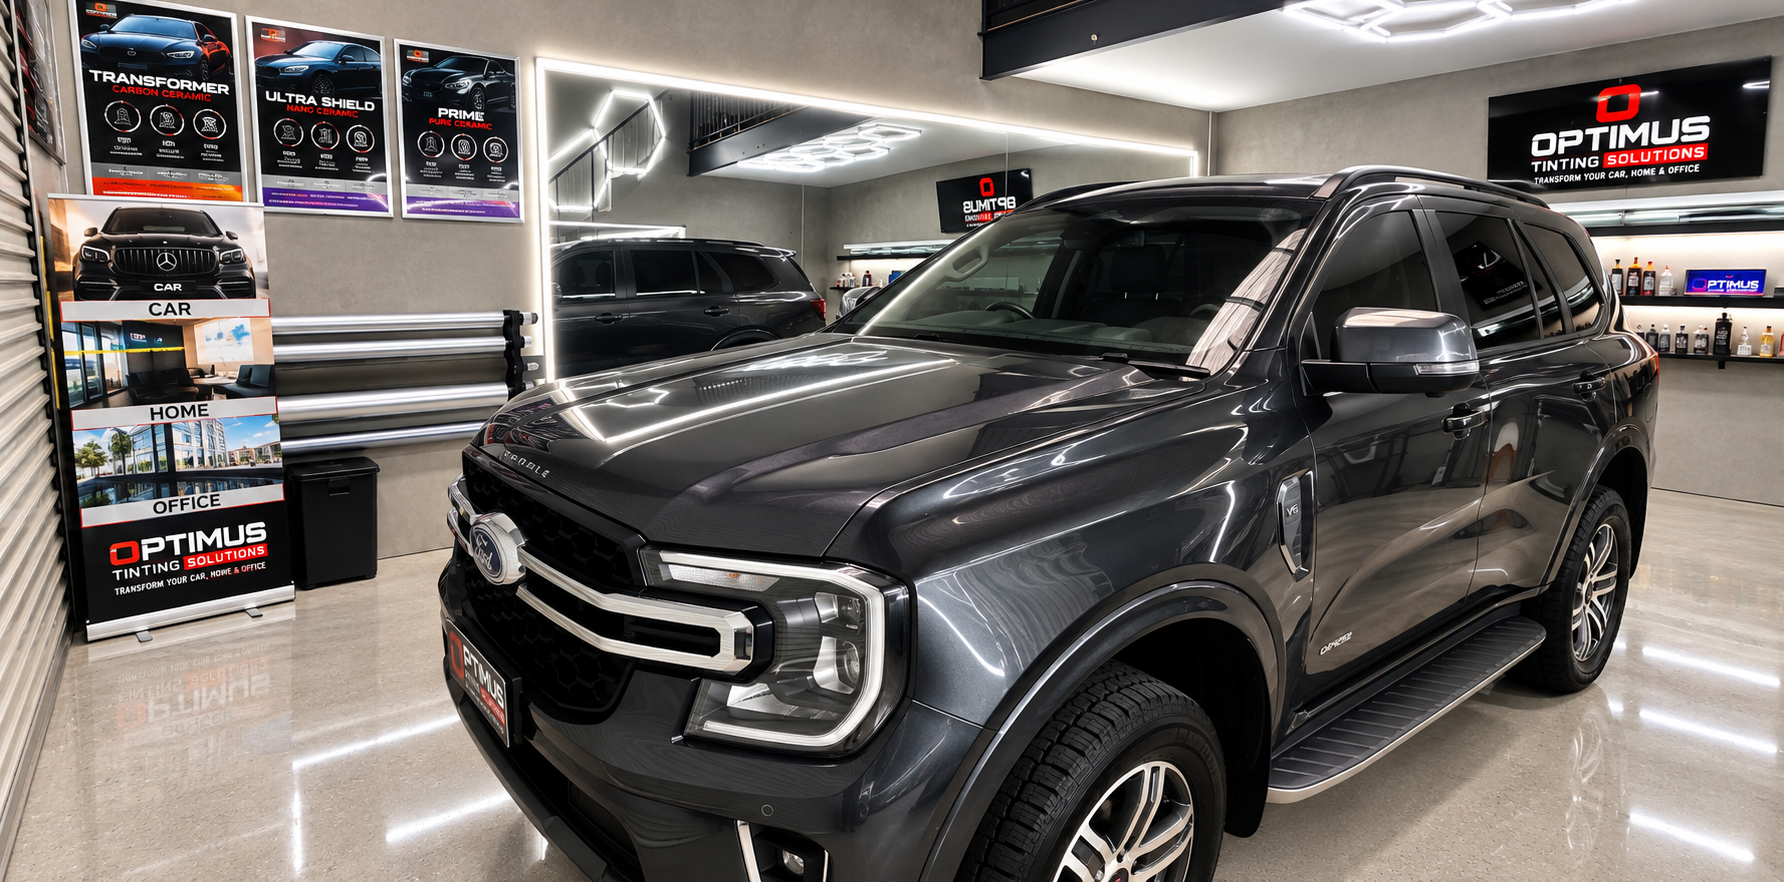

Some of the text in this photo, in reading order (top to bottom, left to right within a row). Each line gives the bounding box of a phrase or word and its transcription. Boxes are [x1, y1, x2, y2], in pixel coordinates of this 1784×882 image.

[89, 69, 230, 95] TRANSFORMER
[112, 84, 212, 102] CARBON CERAMIC
[265, 90, 375, 111] ULTRA SHIELD
[286, 104, 359, 118] NANO CERAMIC
[438, 107, 485, 122] PRIME
[429, 117, 493, 130] PURE CERAMIC
[1531, 115, 1711, 158] OPTIMUS
[1531, 146, 1705, 173] TINTING SOLUTIONS
[1534, 164, 1700, 185] TRANSFORM YOUR CAR, HOME & OFFICE
[153, 283, 182, 292] CAR
[1692, 278, 1760, 292] OPTIMUS
[148, 302, 192, 317] CAR
[149, 403, 210, 421] HOME
[153, 494, 221, 514] OFFICE
[109, 521, 267, 566] OPTIMUS
[112, 545, 265, 581] TINTING SOLUTIONS
[114, 580, 164, 596] TRANSFORM
[166, 575, 188, 587] YOUR
[241, 561, 267, 573] OFFICE
